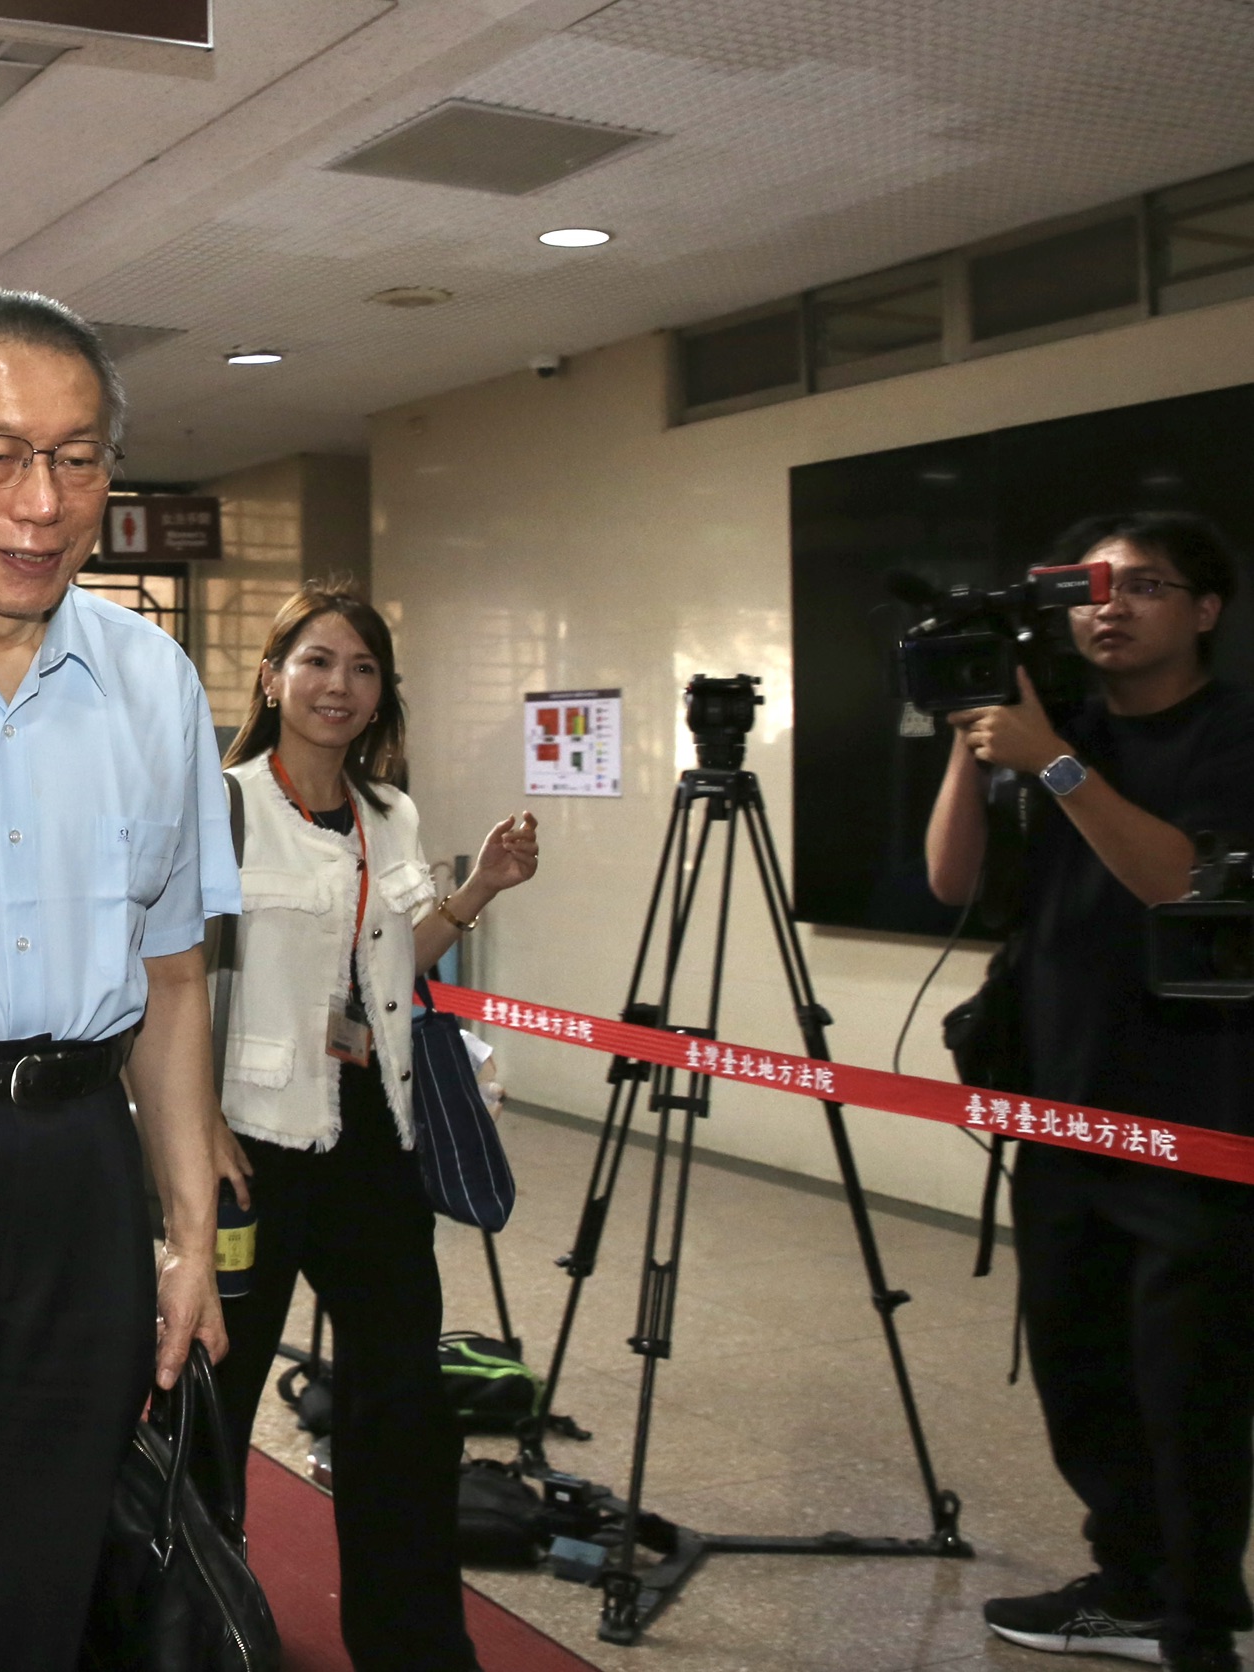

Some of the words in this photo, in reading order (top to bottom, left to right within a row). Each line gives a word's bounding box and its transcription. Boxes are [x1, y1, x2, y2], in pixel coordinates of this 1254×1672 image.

[482, 998, 594, 1042] 臺灣臺北地方法院
[685, 1040, 835, 1093] 臺灣臺北地方法院
[965, 1093, 1179, 1162] 臺灣臺北地方法院
